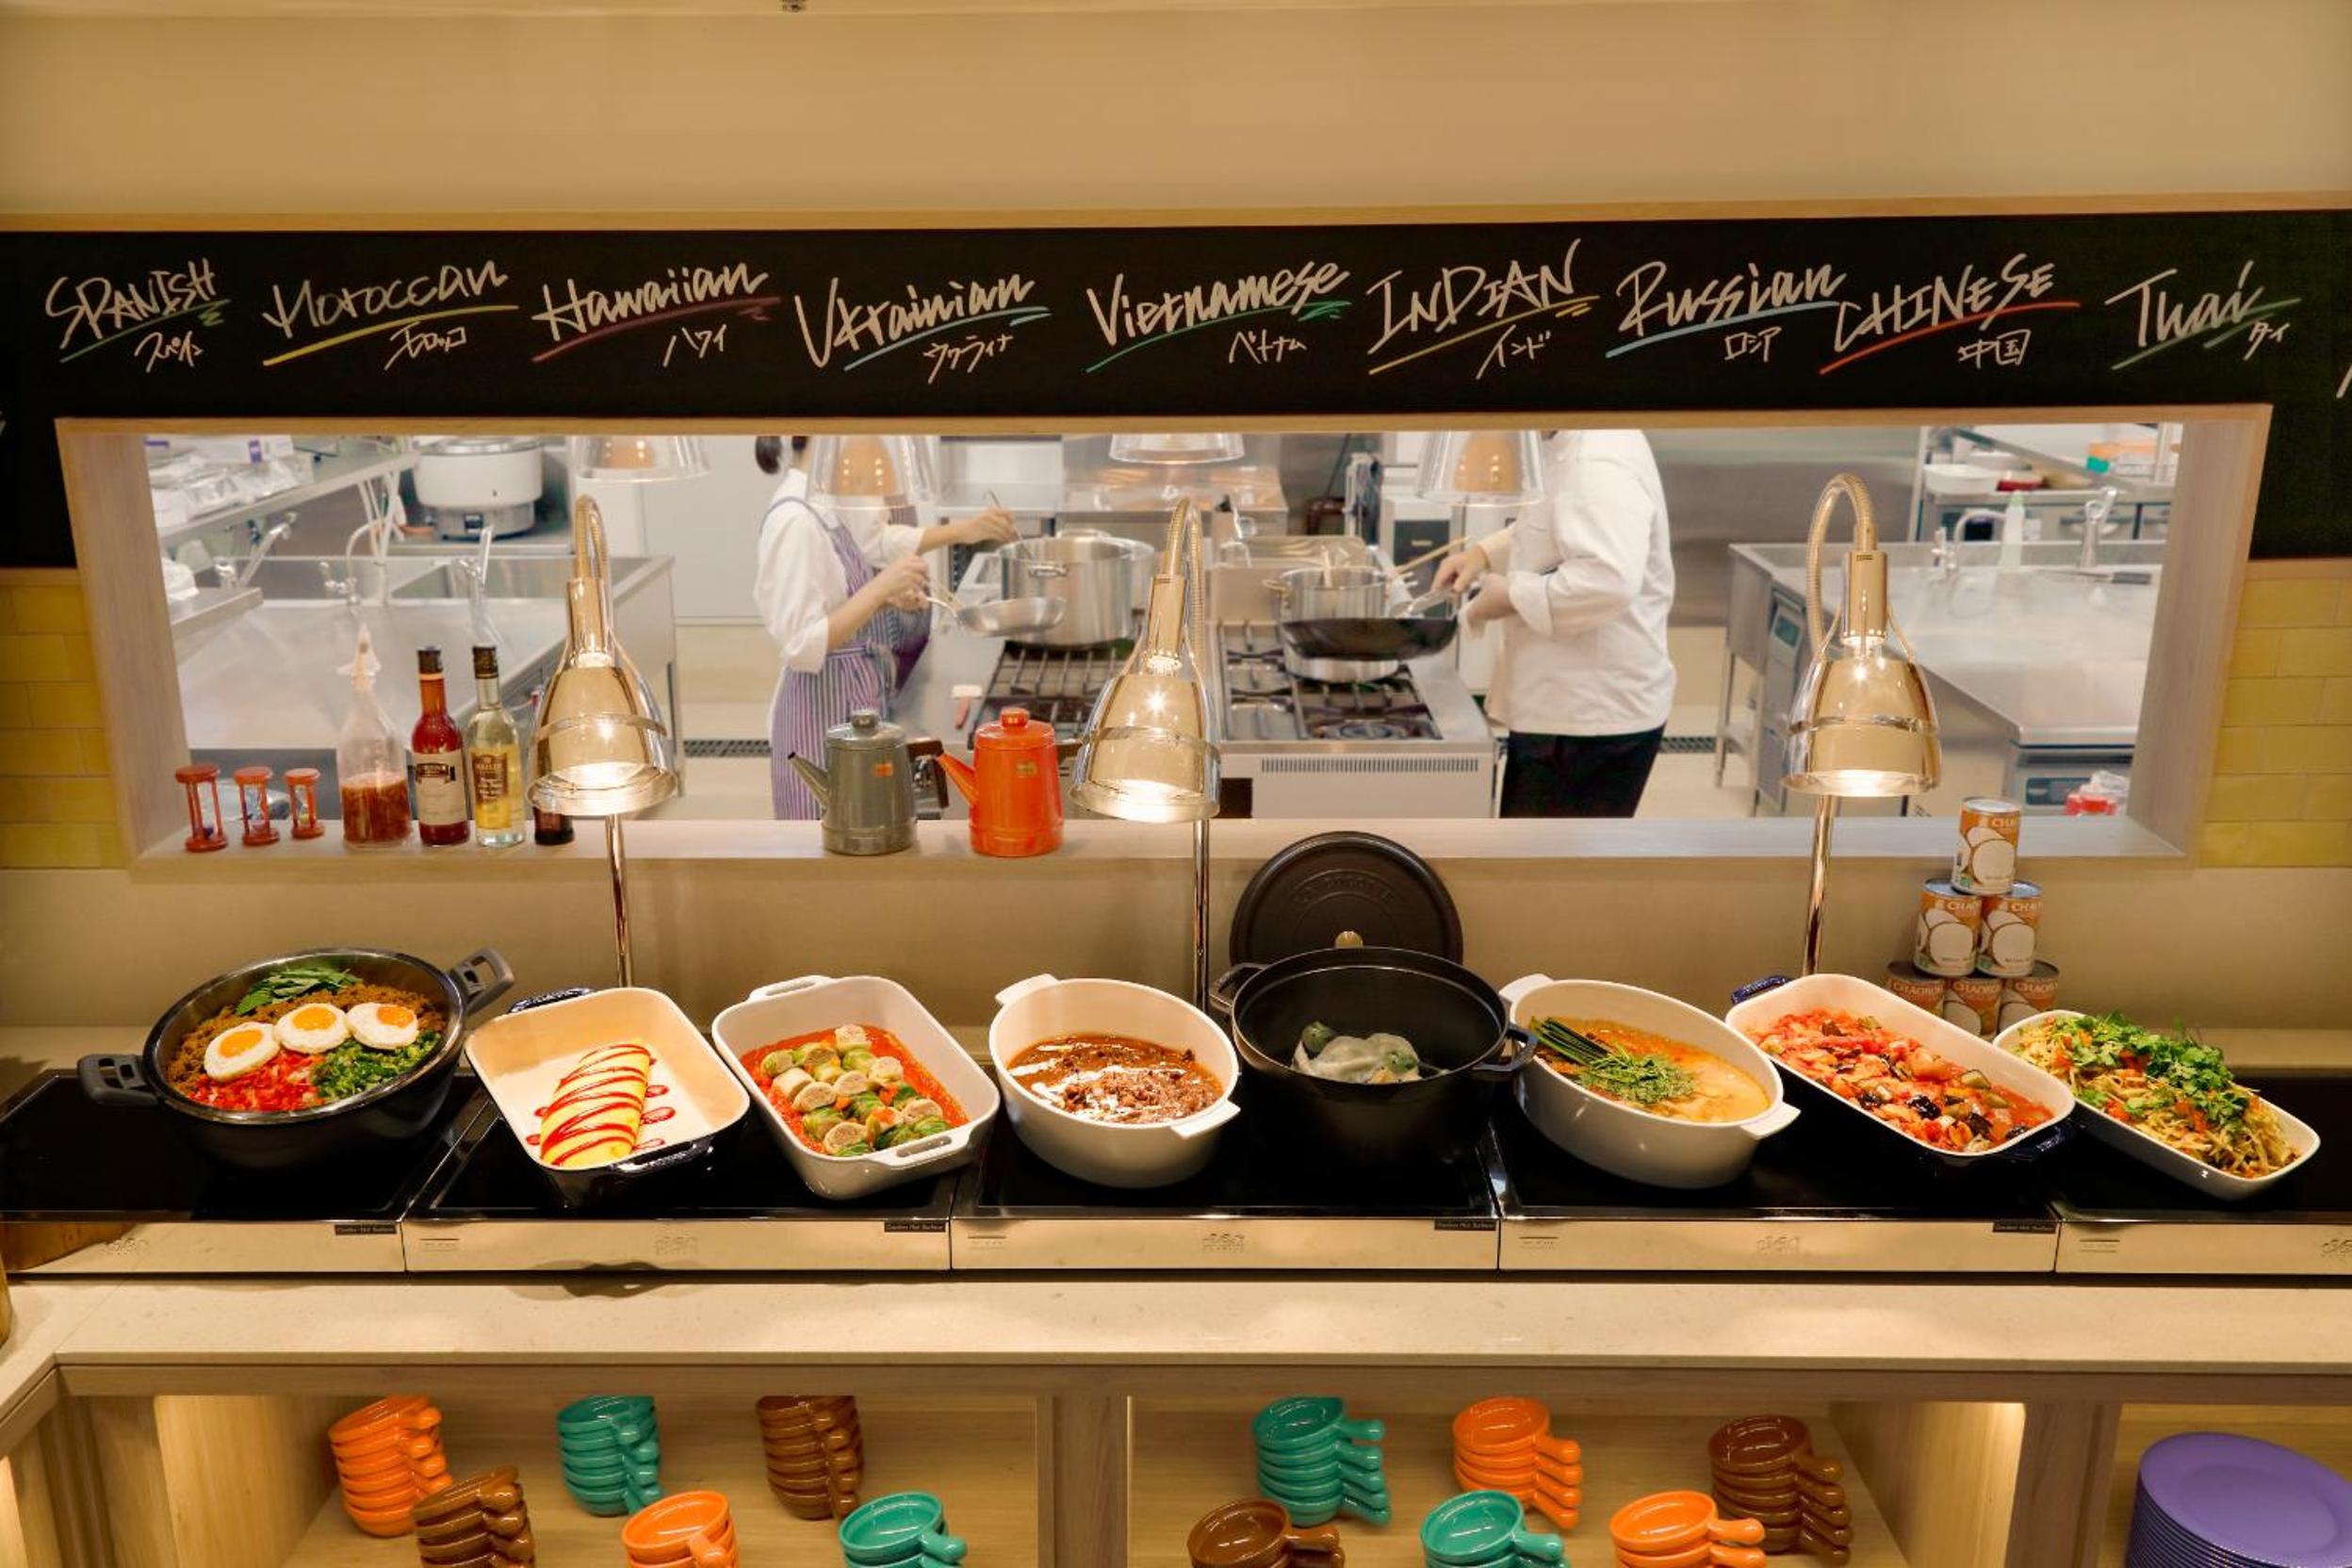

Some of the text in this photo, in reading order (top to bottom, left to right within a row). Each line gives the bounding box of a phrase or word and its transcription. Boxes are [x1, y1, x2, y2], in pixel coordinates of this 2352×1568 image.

[45, 257, 216, 350] SPANISH
[262, 260, 509, 339] Moroccan
[531, 262, 770, 341] Hawaiian
[1086, 260, 1351, 347] Vietnamese
[1365, 237, 1581, 355] INDIAN
[1616, 260, 1847, 336] Russian
[1834, 253, 2055, 352] CHINESE
[2104, 259, 2265, 348] Thai
[662, 323, 727, 368] ハワイ
[923, 333, 1014, 384] ウクライナ
[1228, 329, 1308, 365] ベトナム
[1476, 324, 1551, 380] インド
[1723, 325, 1782, 363] ロシア
[1956, 329, 2032, 368] 中国
[2243, 320, 2291, 362] タイ
